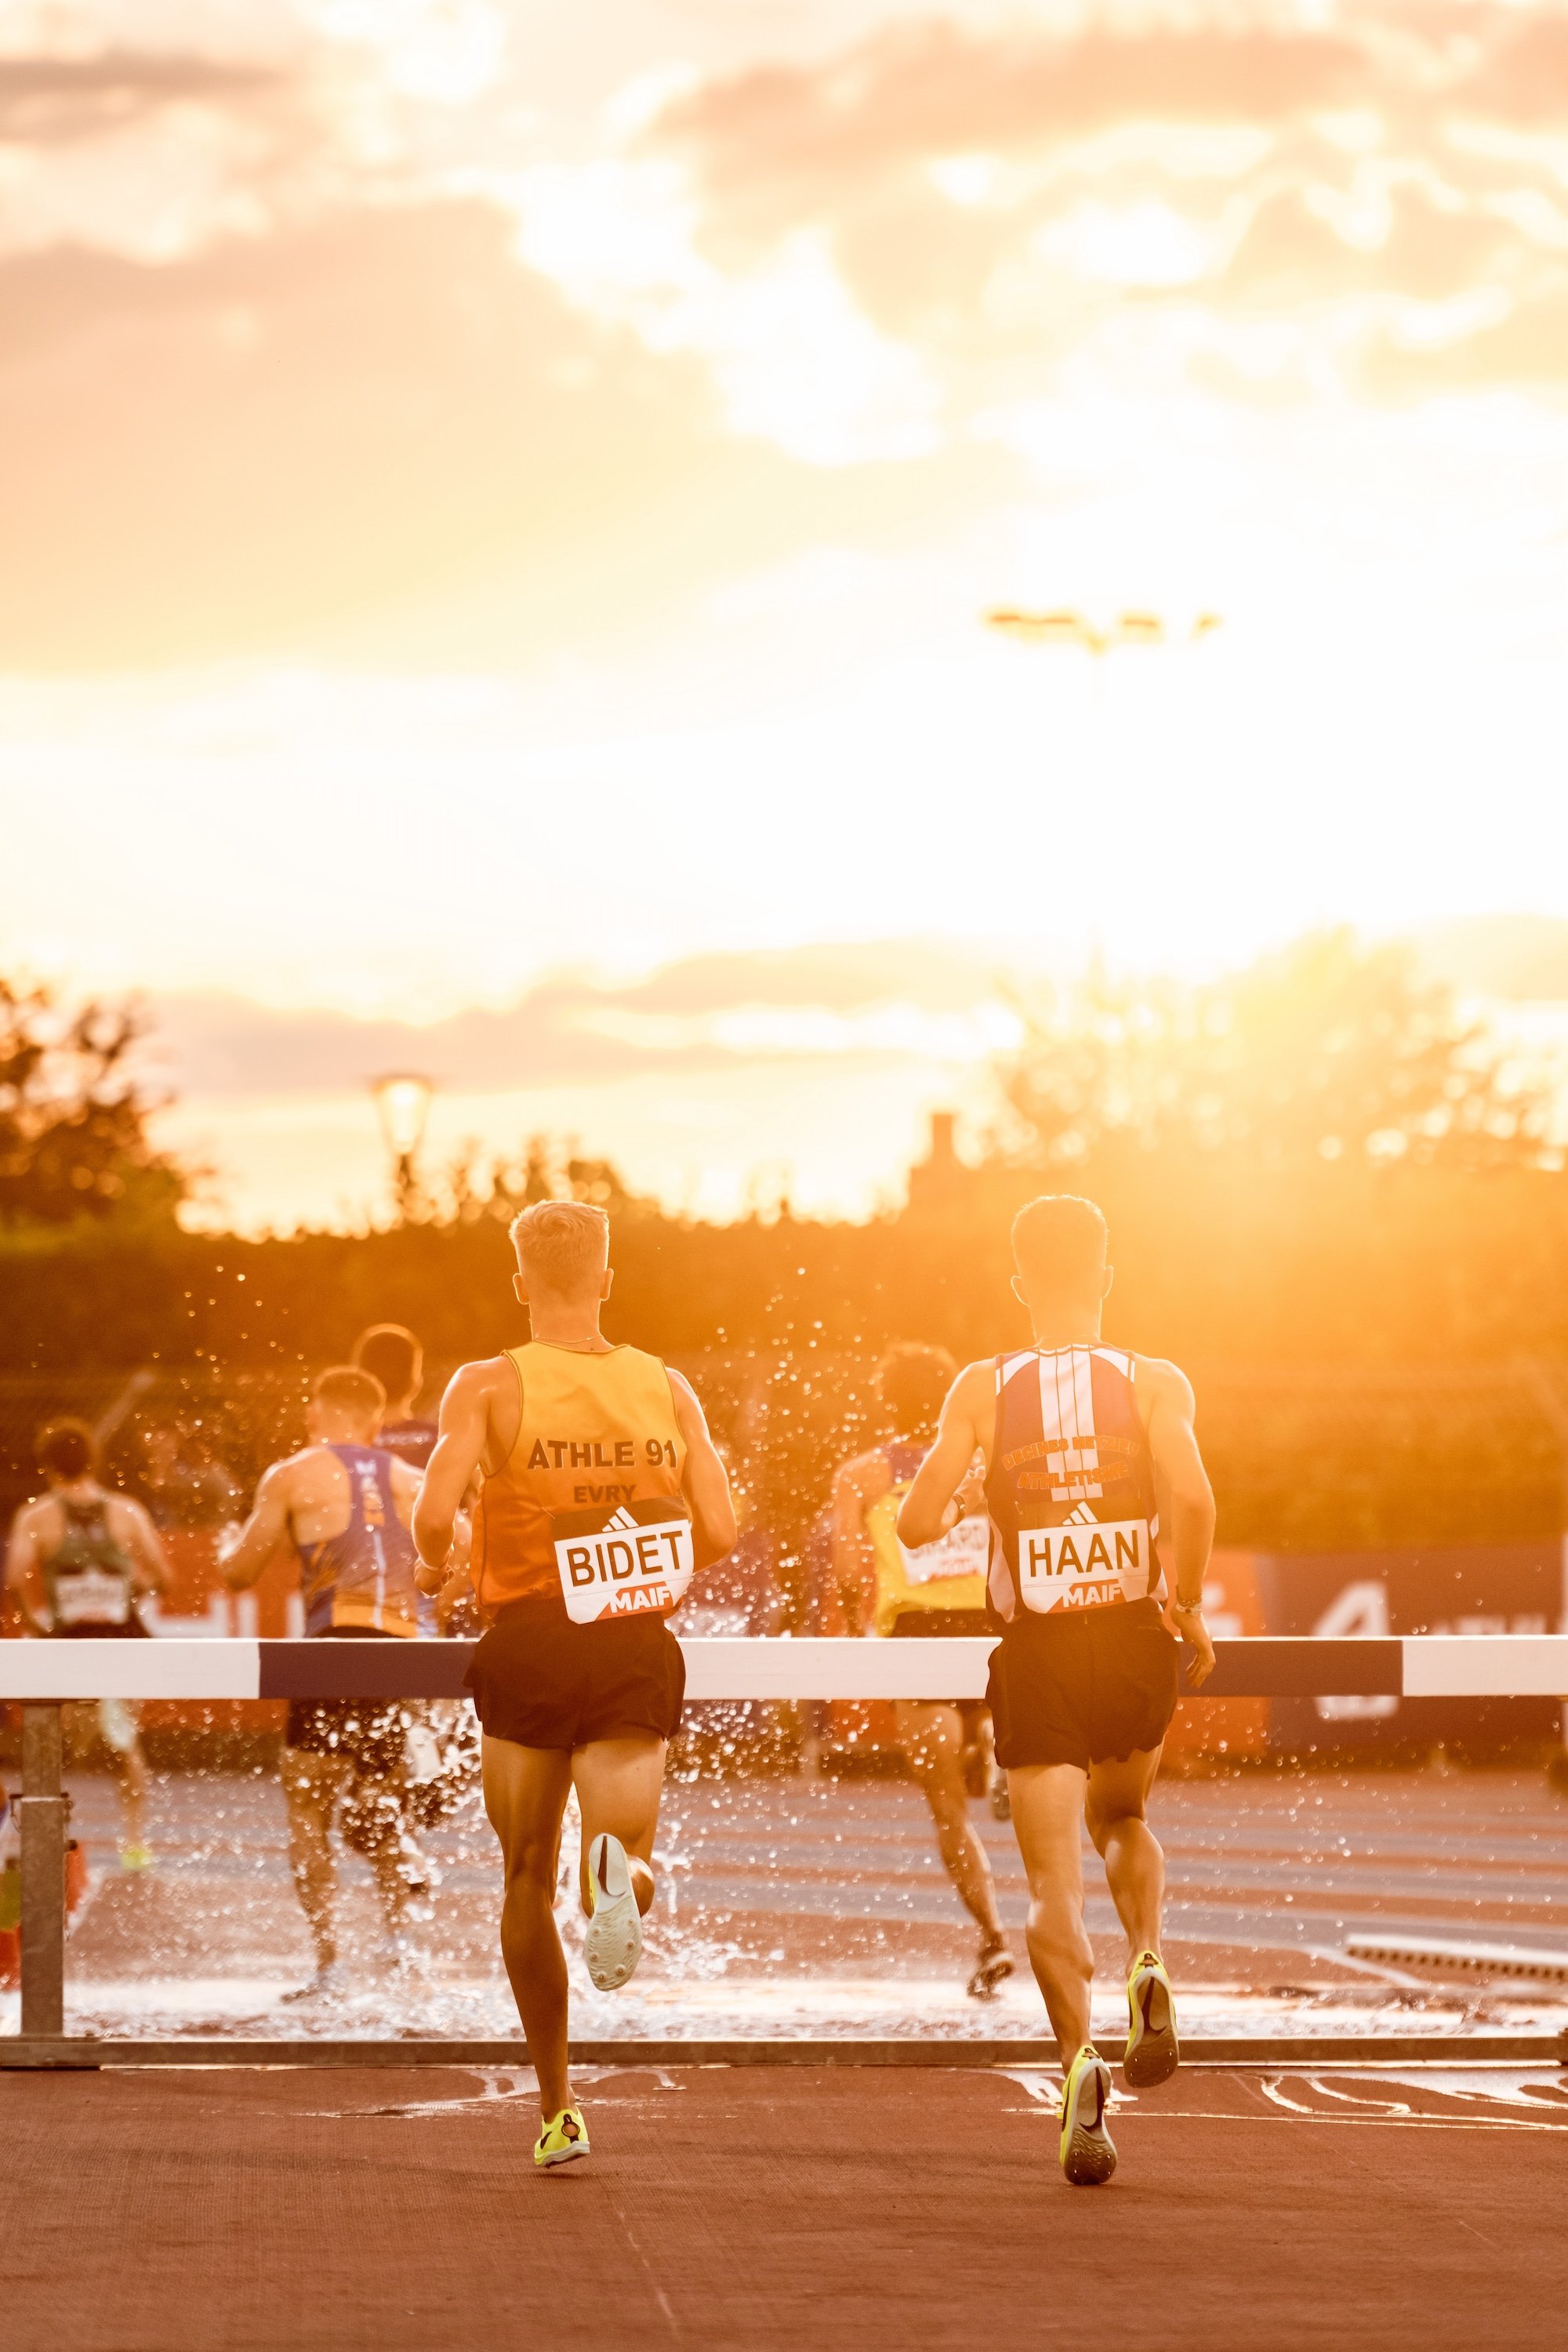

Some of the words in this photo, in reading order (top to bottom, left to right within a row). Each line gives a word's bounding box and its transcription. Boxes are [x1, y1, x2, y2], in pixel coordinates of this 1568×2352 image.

[527, 1438, 636, 1470] ATHLE
[645, 1439, 678, 1468] 91
[1001, 1438, 1069, 1471] DECINES
[1017, 1460, 1131, 1490] ATHLETISME
[574, 1484, 637, 1504] EVRY
[567, 1530, 684, 1588] BIDET
[1029, 1530, 1140, 1578] HAAN
[609, 1585, 673, 1613] MAIF
[1062, 1583, 1125, 1608] MAIF
